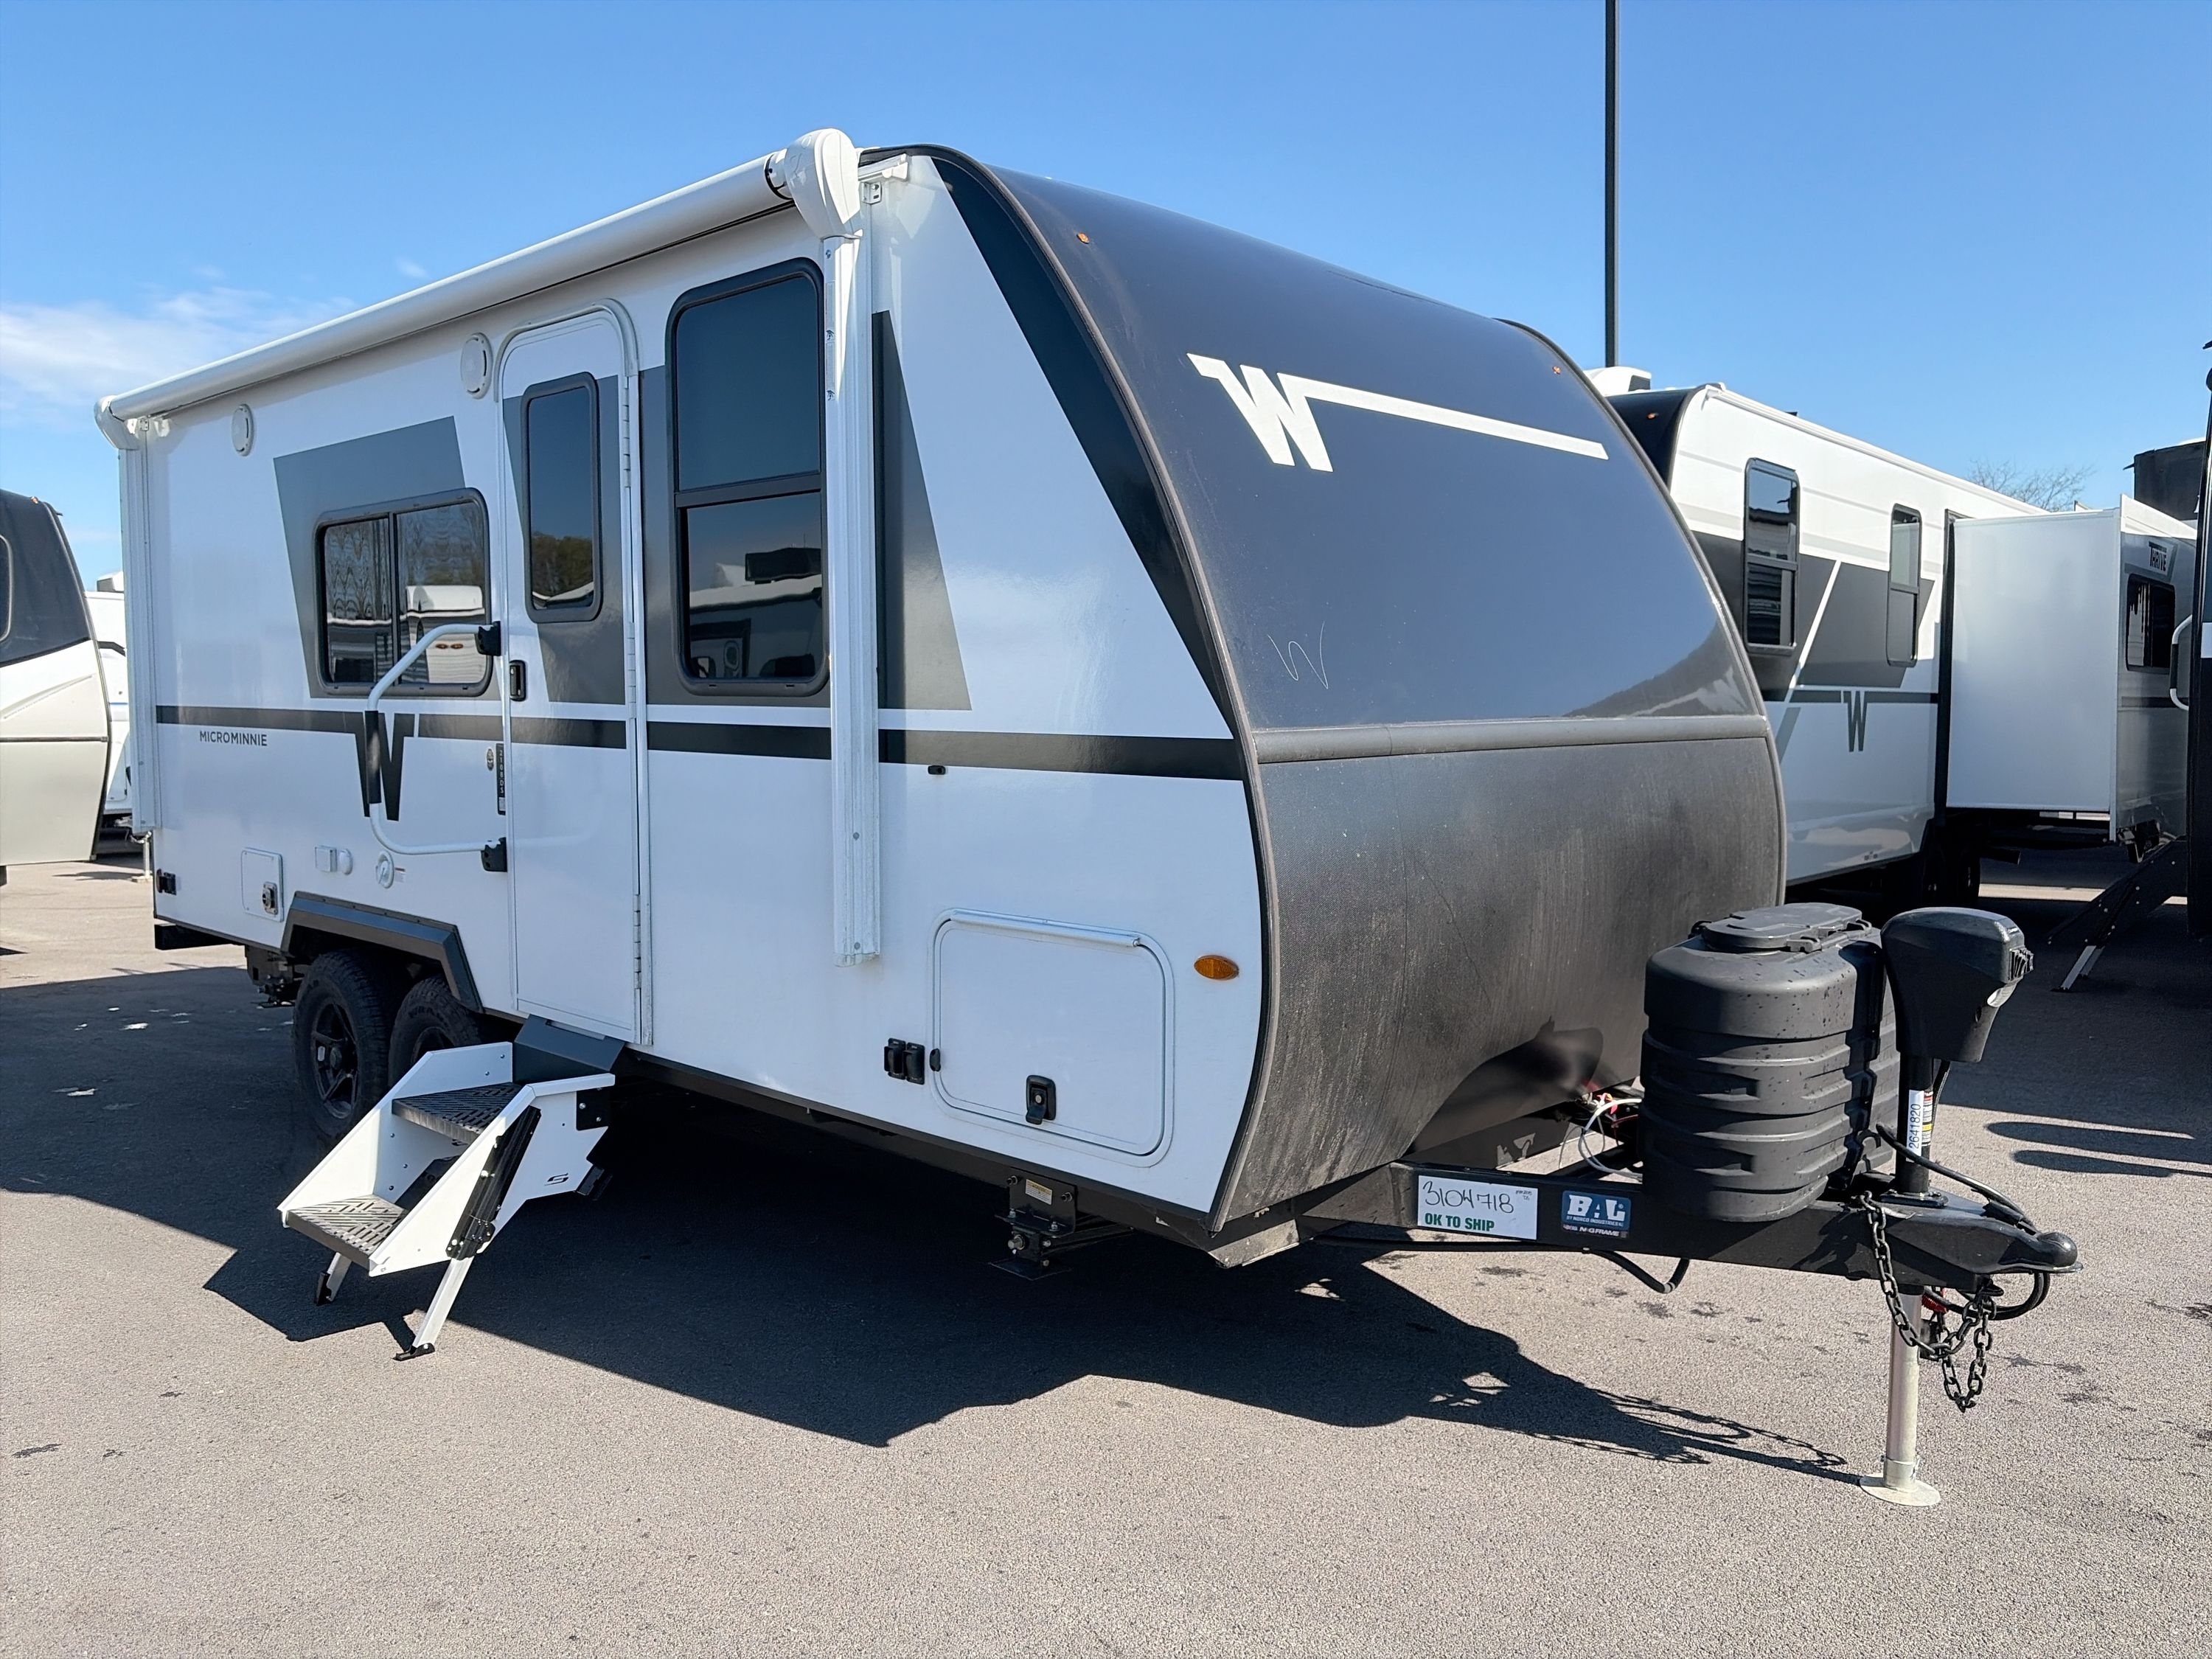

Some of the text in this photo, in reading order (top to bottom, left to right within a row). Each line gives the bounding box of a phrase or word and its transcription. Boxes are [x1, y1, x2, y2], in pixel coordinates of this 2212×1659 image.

[200, 731, 267, 746] MICROMINNIE
[1908, 1103, 1921, 1149] 2641820
[1422, 1180, 1514, 1214] 3104718
[1567, 1194, 1626, 1222] BAL
[1425, 1212, 1495, 1231] OK TO SHIP
